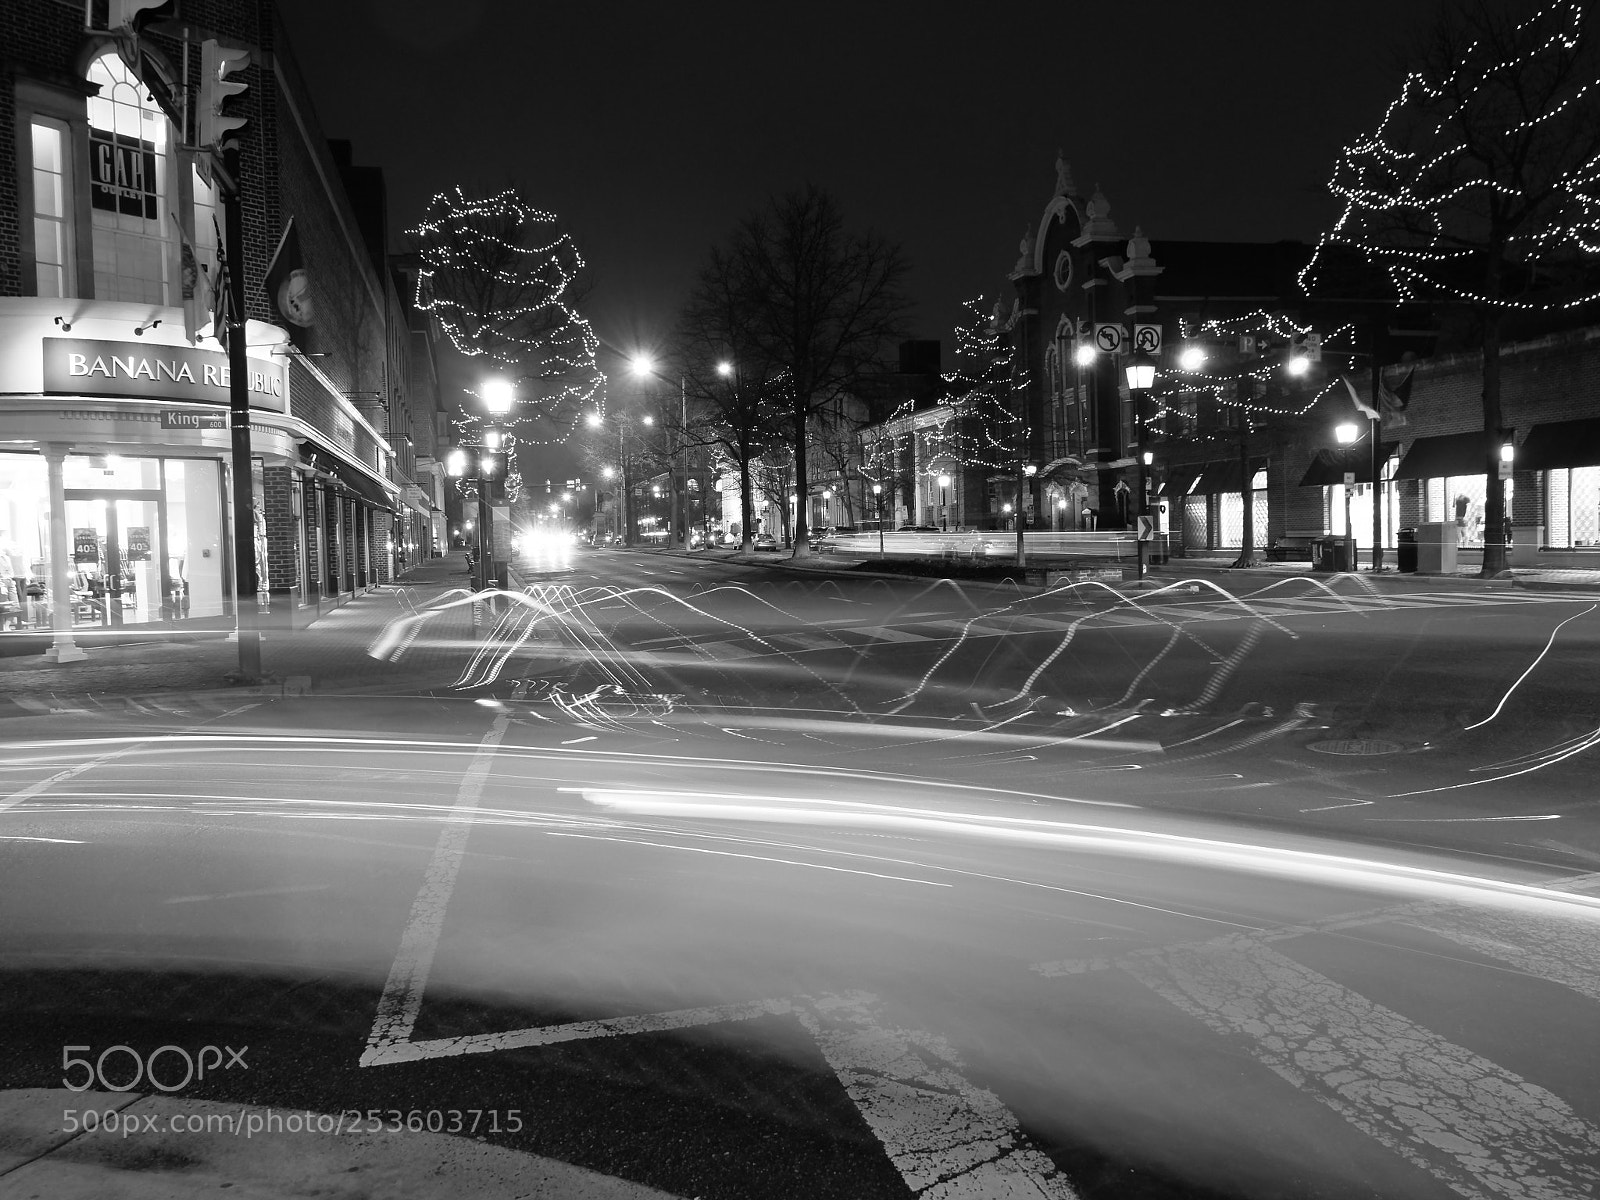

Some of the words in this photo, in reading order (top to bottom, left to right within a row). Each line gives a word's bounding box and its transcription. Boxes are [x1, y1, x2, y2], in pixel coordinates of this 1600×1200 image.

[98, 144, 143, 190] GAP
[100, 184, 143, 201] OUTLET
[68, 352, 196, 385] BANANA
[203, 363, 283, 398] REUBLIC
[167, 412, 199, 429] King
